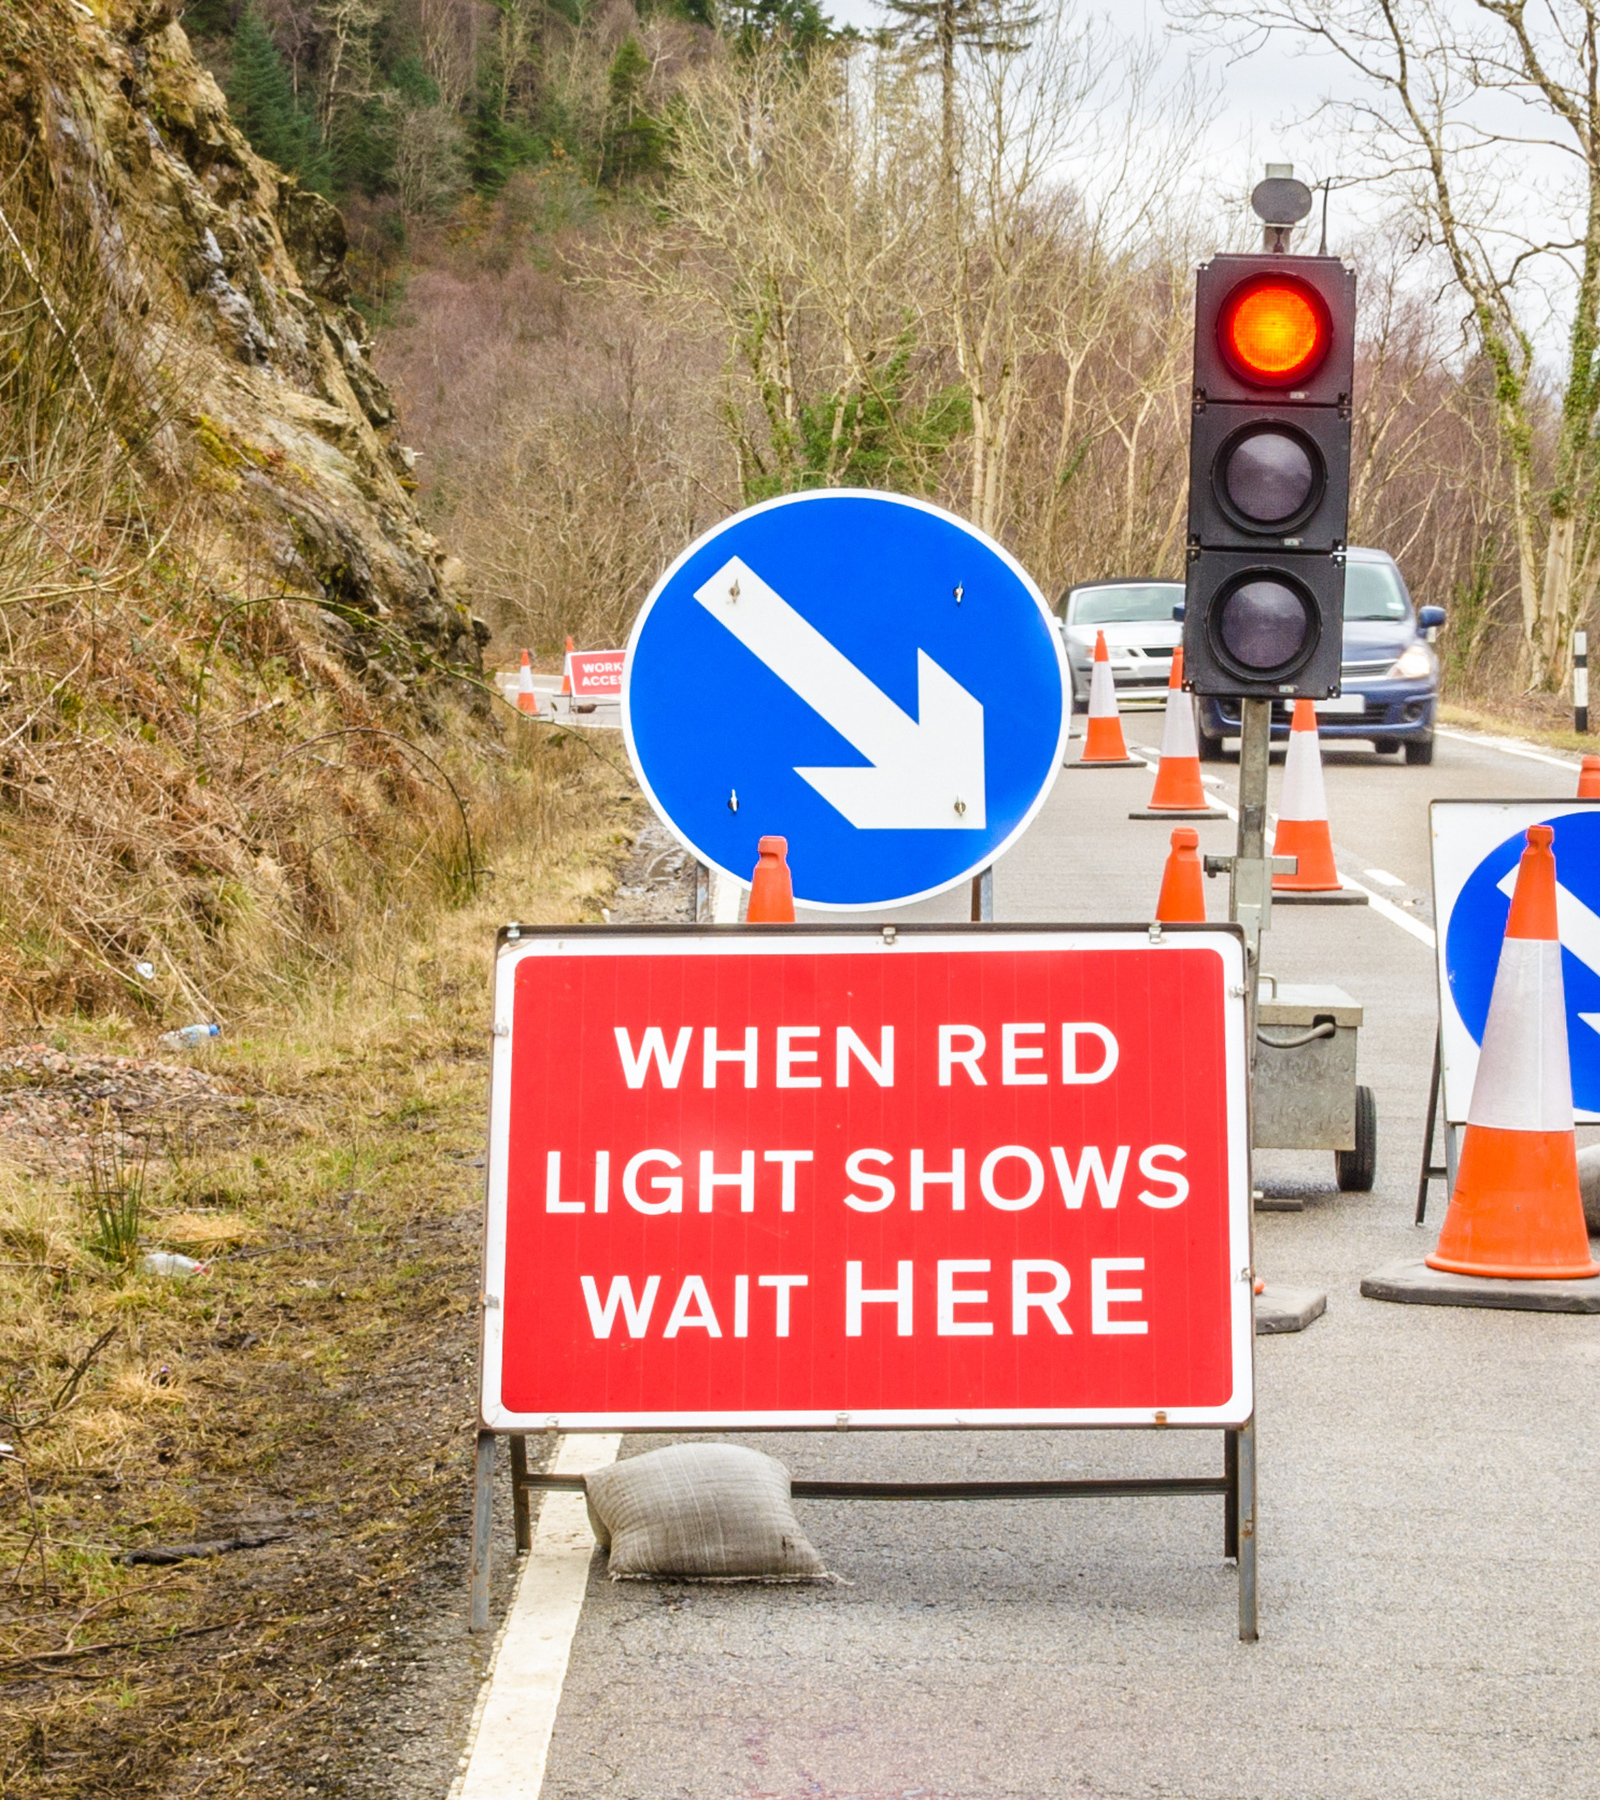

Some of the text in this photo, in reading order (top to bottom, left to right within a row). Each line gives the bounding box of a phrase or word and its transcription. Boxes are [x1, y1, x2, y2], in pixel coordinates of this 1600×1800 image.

[582, 662, 623, 673] WORK
[614, 1022, 1119, 1089] WHEN RED
[546, 1144, 1189, 1215] LIGHT SHOWS
[581, 1258, 1148, 1338] WAIT HERE
